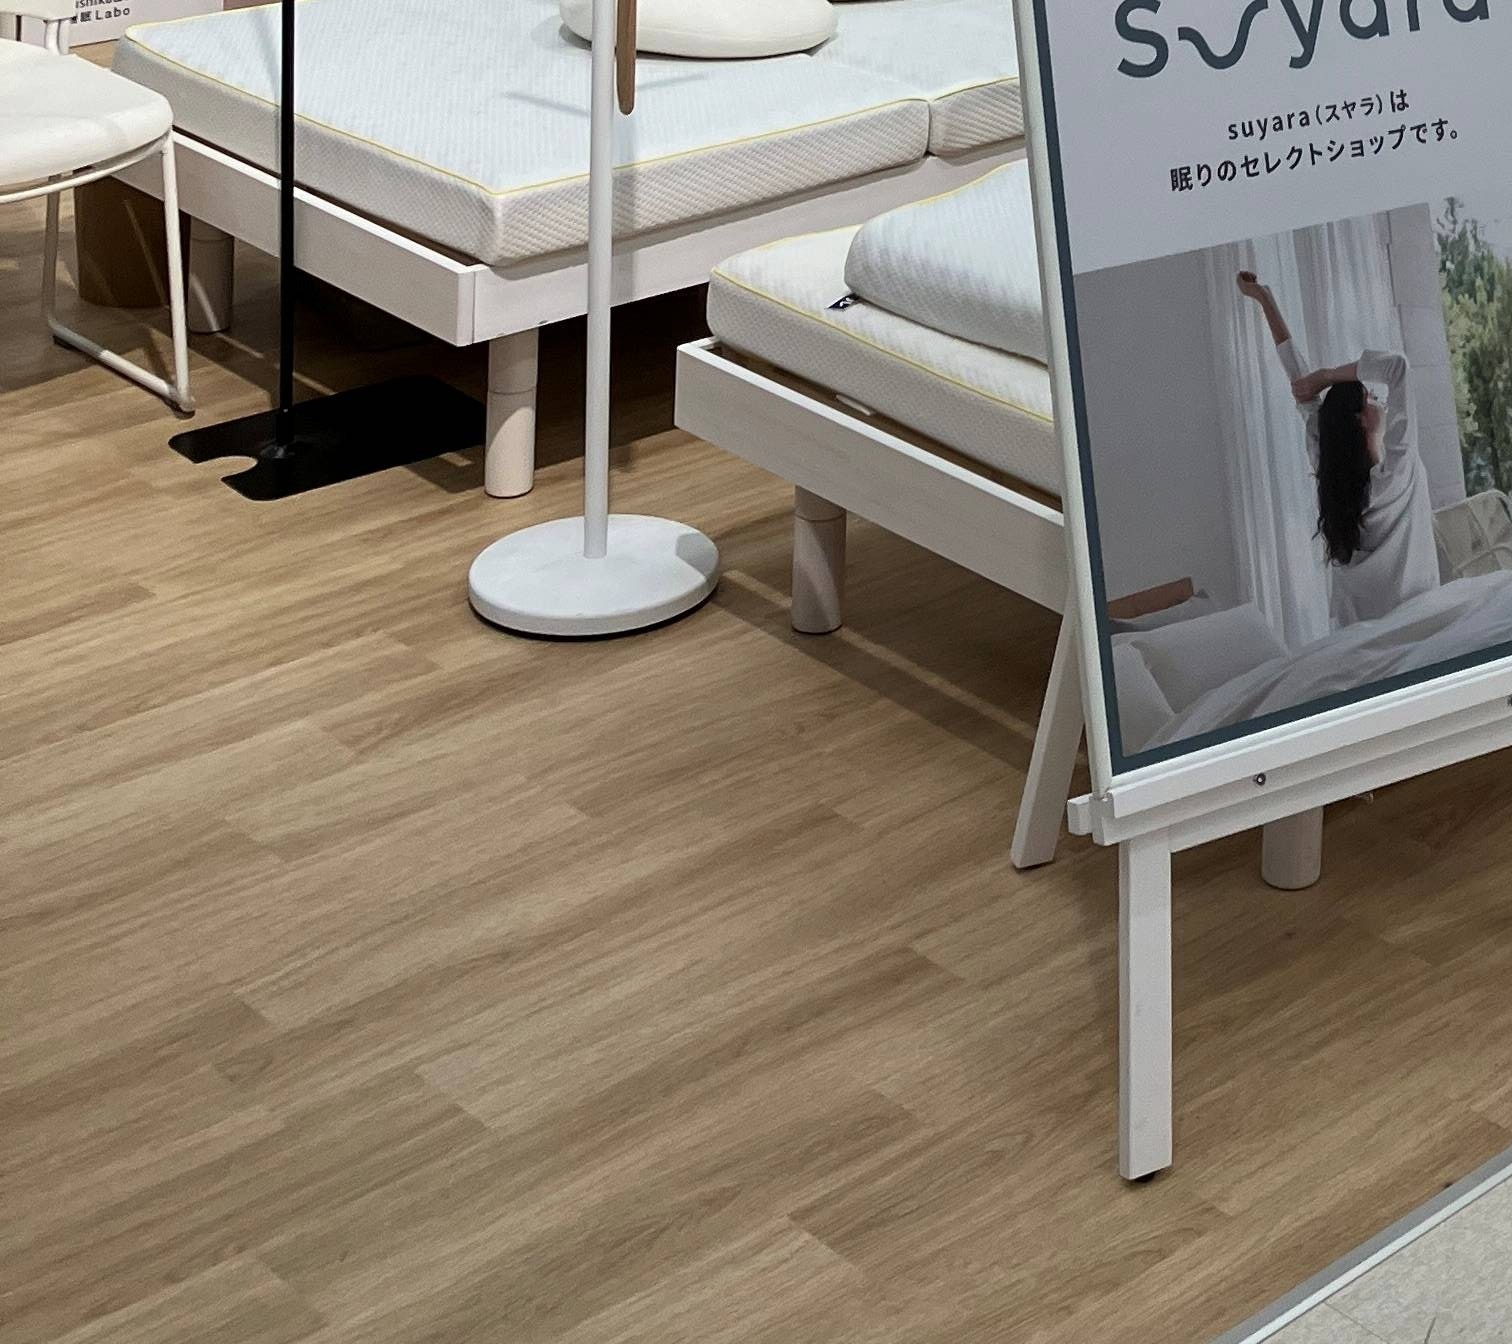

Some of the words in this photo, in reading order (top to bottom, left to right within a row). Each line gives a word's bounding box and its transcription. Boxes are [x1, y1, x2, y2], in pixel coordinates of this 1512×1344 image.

[95, 7, 130, 21] Labo
[1170, 117, 1459, 192] 眠りのセレクトショップです。
